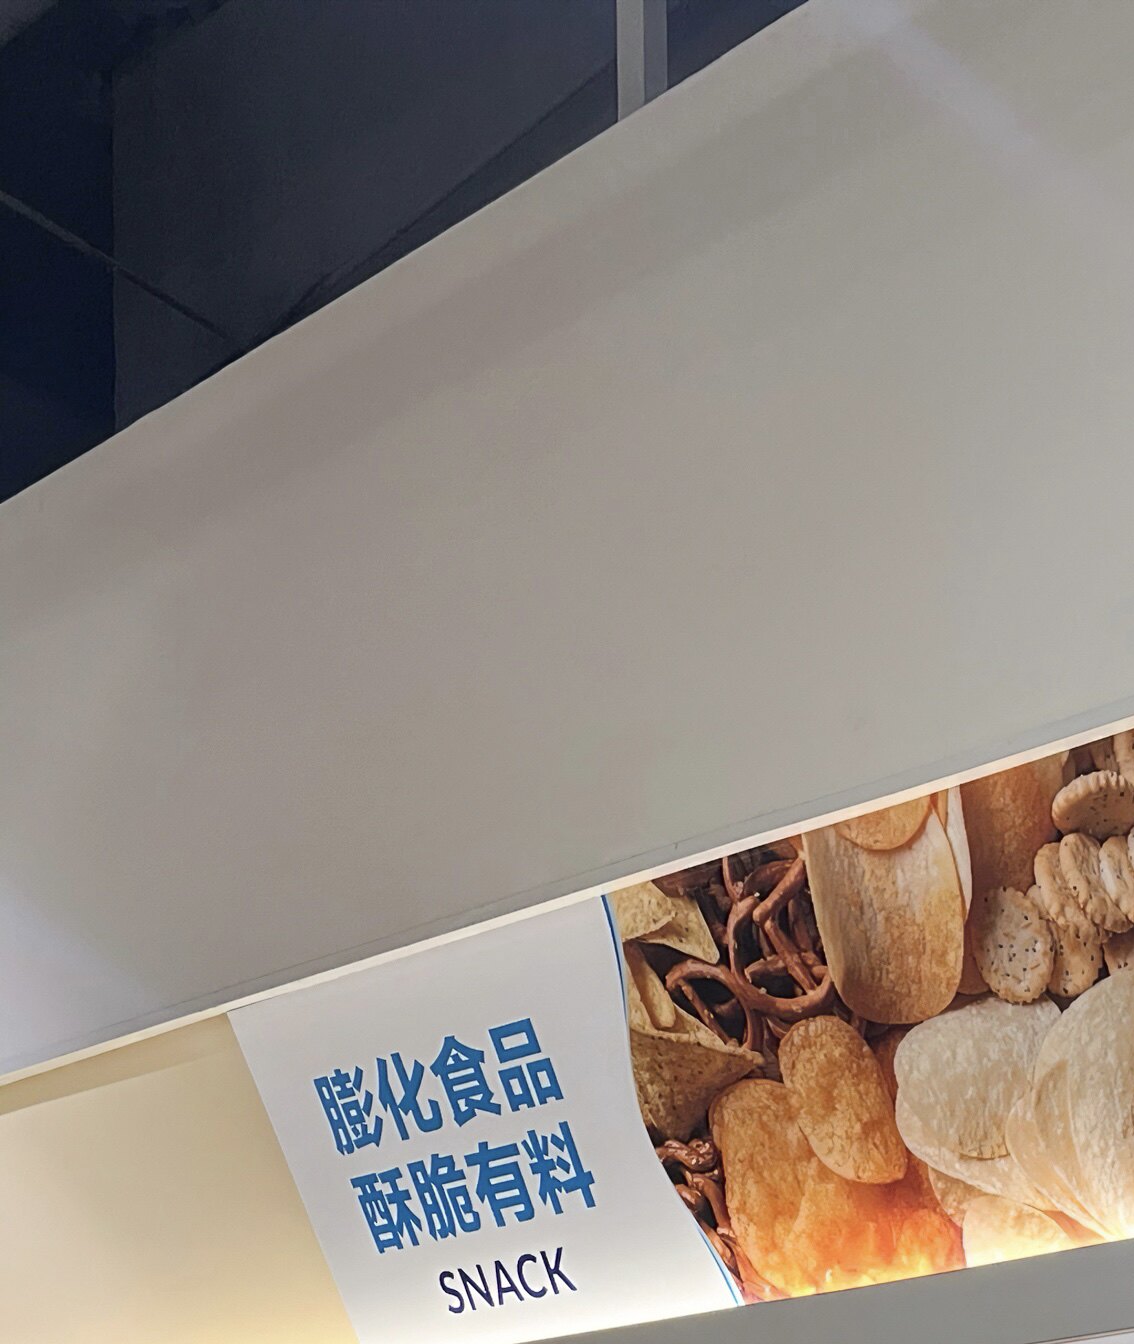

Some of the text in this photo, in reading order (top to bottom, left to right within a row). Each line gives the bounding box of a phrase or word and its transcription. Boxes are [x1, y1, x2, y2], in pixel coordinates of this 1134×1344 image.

[313, 1017, 564, 1155] 膨化食品
[350, 1121, 597, 1254] 酥脆有料
[439, 1247, 578, 1314] SNACK
